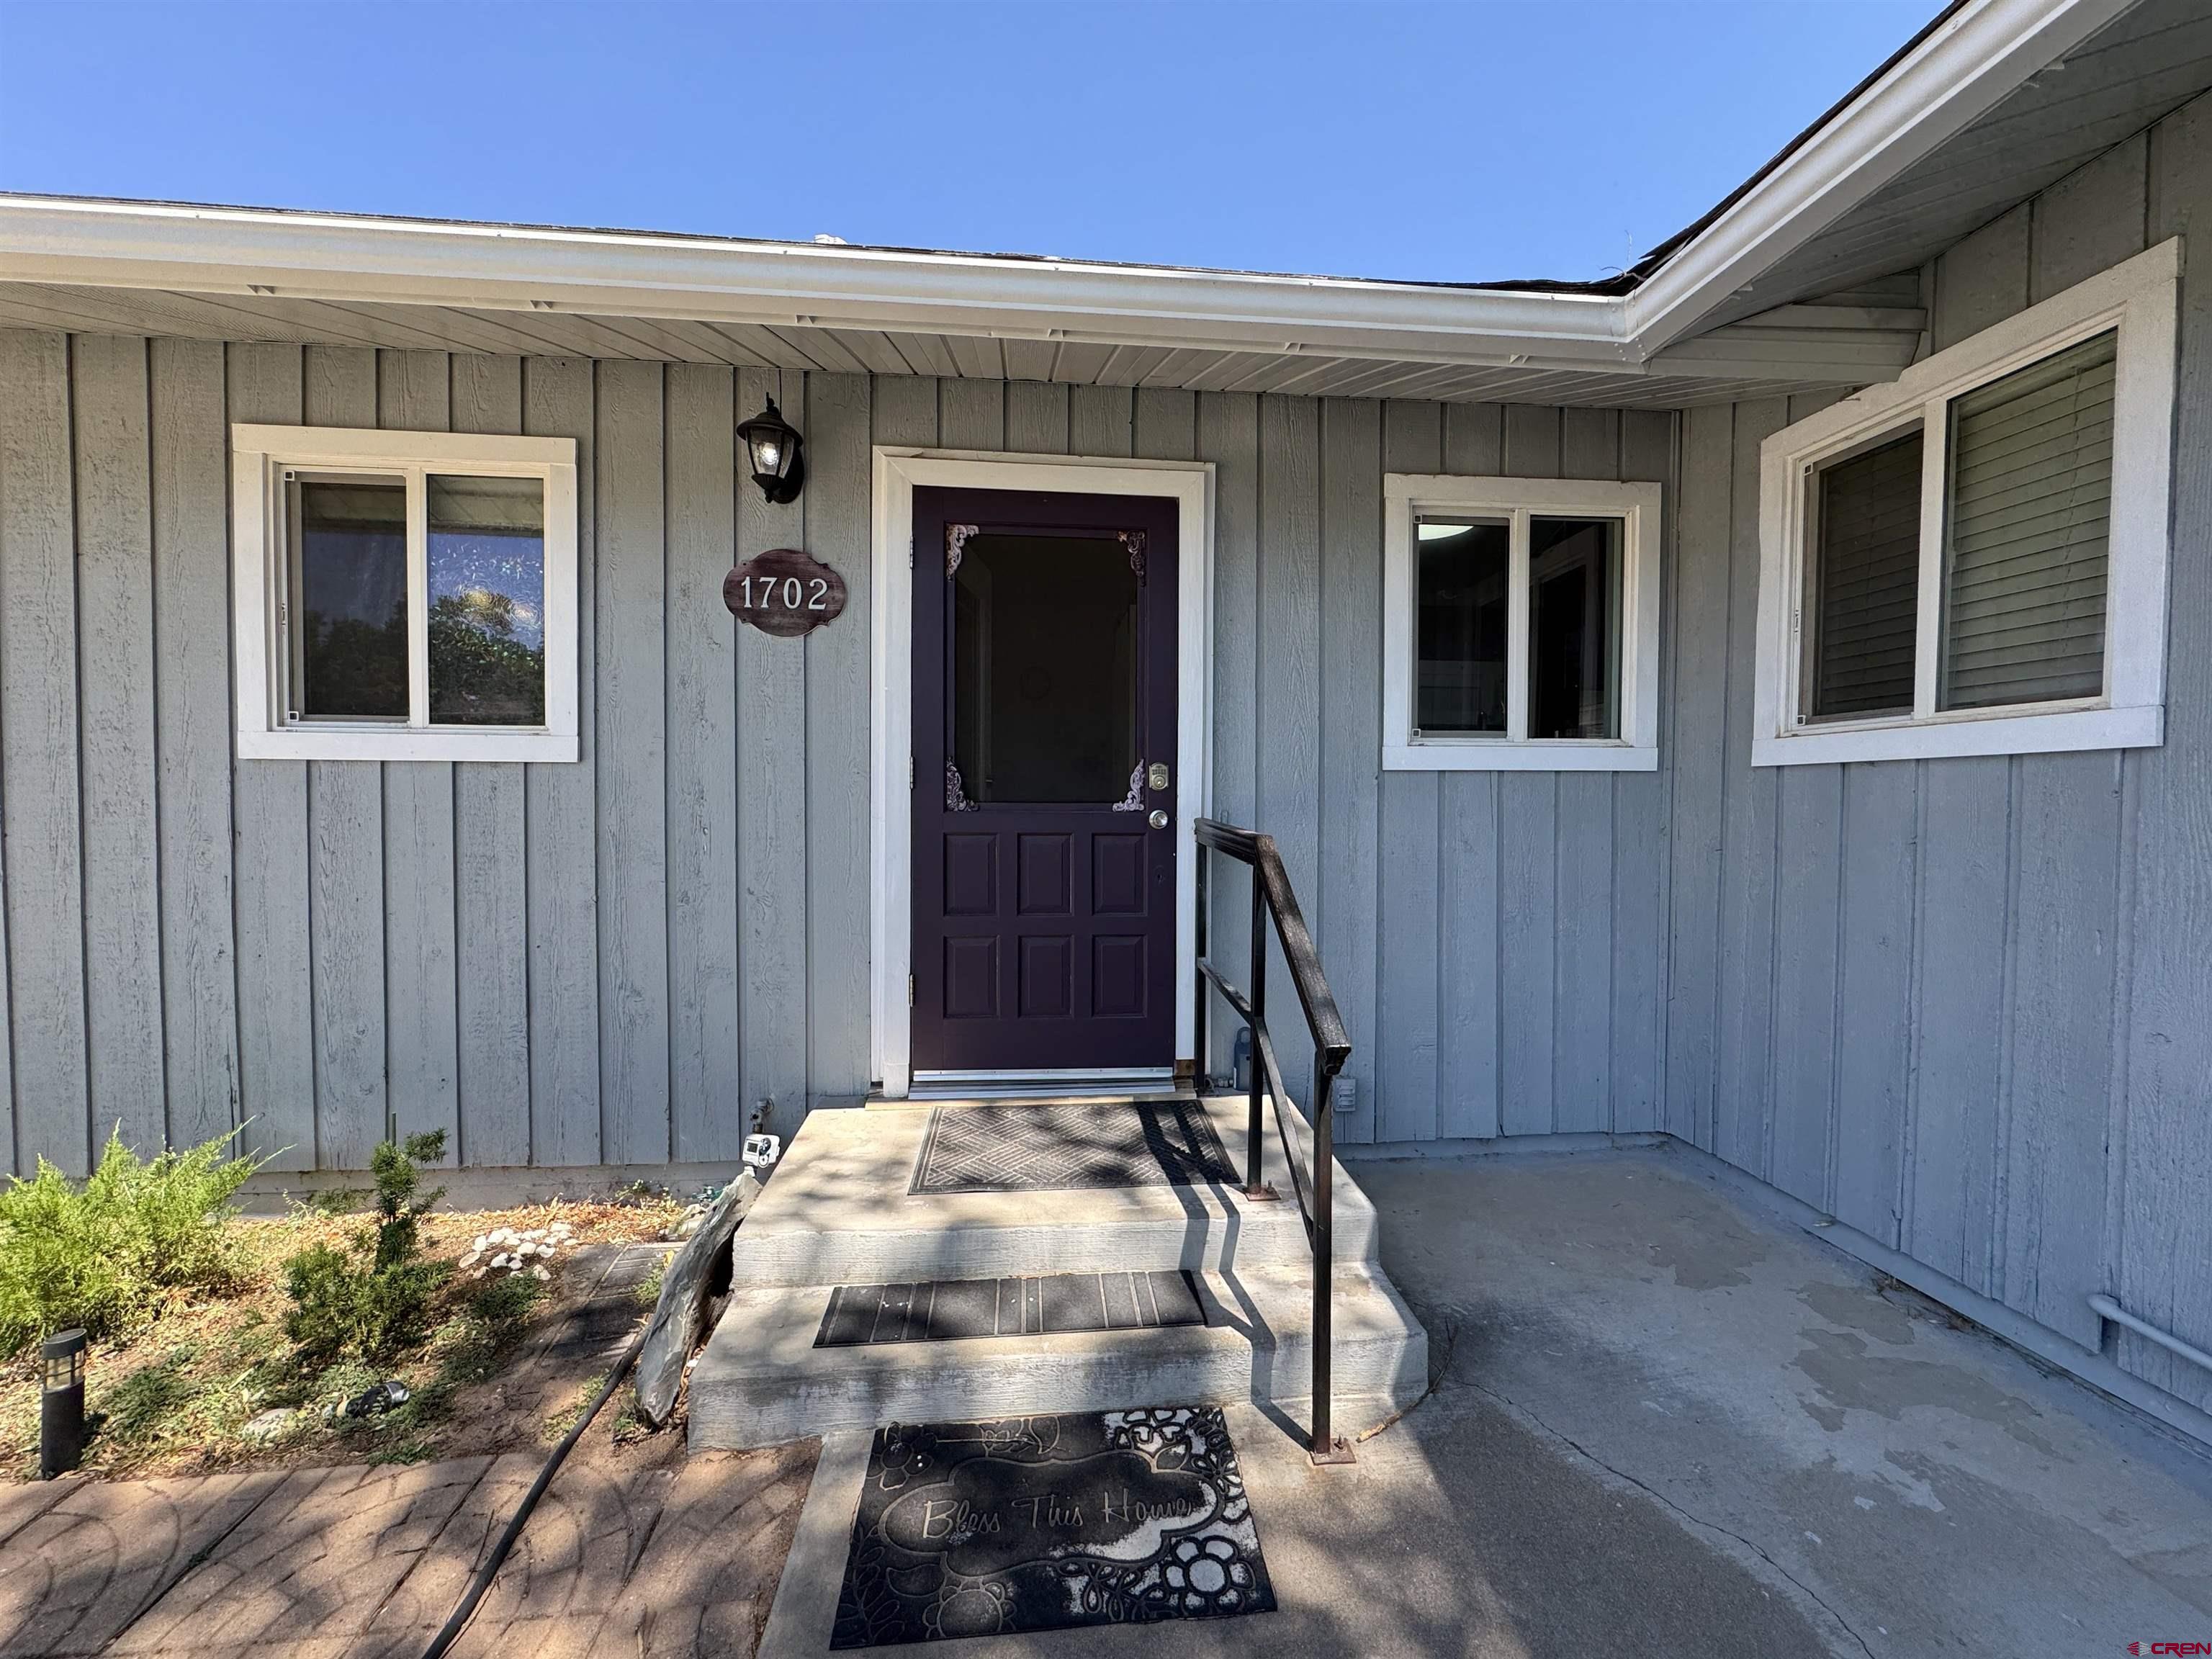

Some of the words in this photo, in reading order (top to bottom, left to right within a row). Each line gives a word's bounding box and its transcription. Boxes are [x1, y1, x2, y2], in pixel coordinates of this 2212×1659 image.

[741, 576, 828, 610] 1702
[923, 1500, 1000, 1538] Bless
[1011, 1494, 1084, 1529] This
[1101, 1488, 1192, 1523] Home
